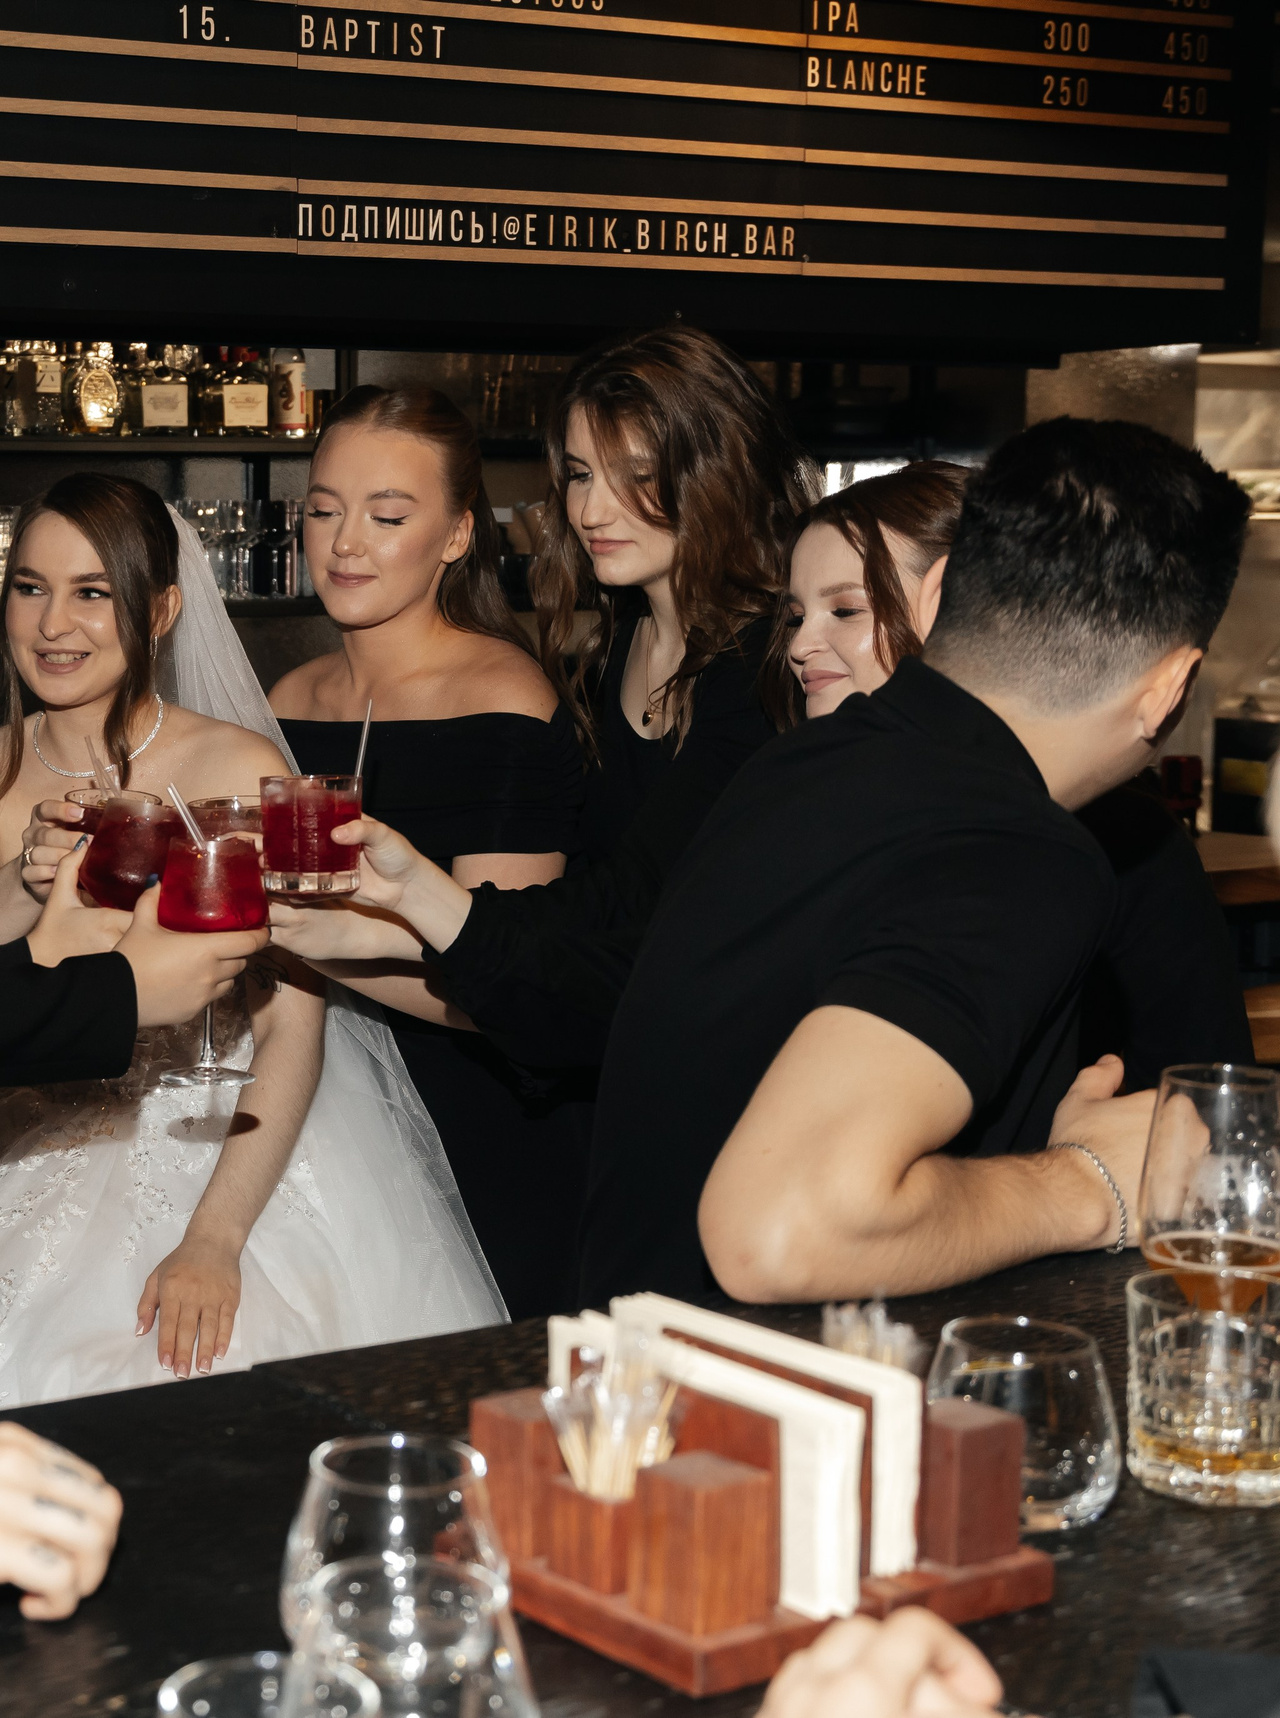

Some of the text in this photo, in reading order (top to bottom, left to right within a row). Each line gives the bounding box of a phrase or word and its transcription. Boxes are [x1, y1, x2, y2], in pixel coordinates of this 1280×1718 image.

[179, 4, 1209, 116] 15. BAPTIST BLANCHE 250 450
[812, 0, 1210, 63] IPA 300 450
